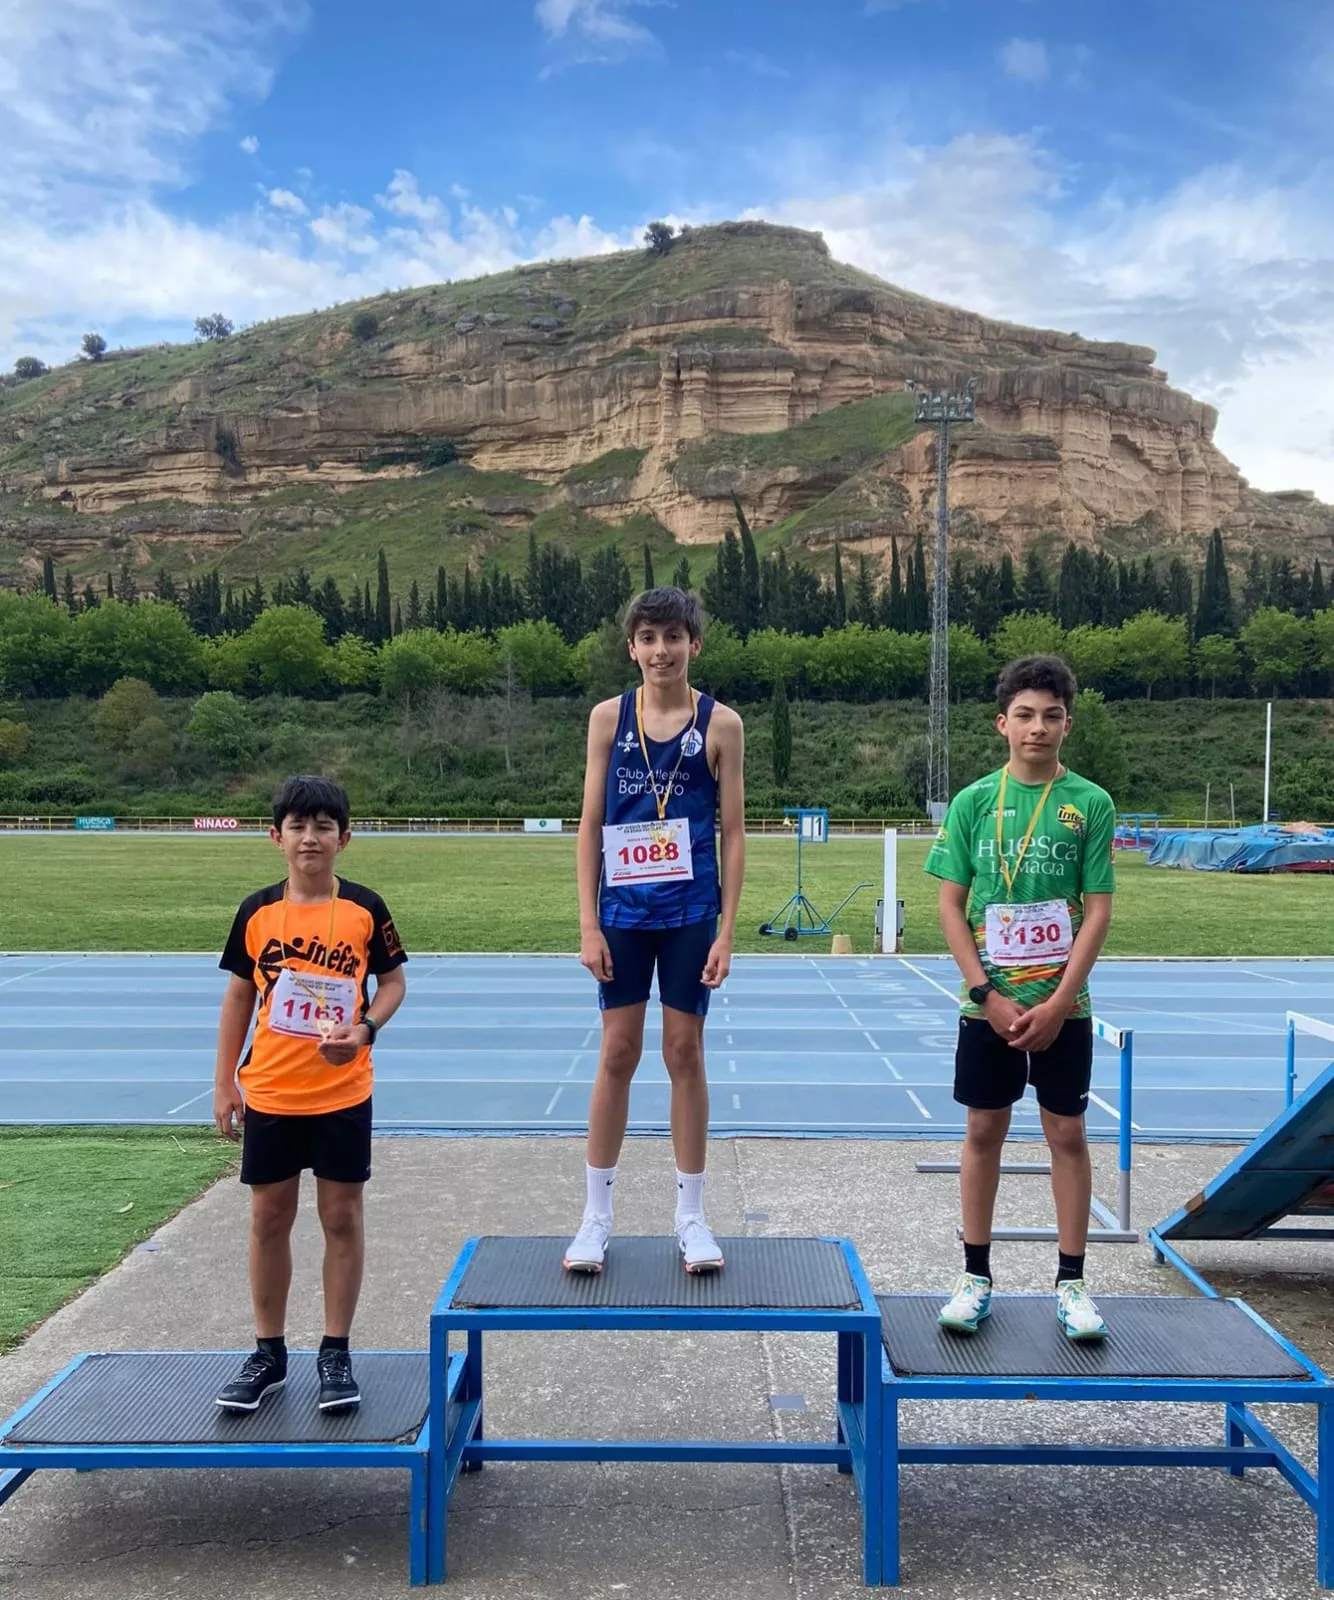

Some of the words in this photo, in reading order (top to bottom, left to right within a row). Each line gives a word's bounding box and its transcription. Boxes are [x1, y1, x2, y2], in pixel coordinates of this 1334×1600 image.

[616, 767, 643, 780] Club
[194, 818, 238, 829] HINACO
[618, 842, 679, 865] 1088
[999, 923, 1061, 945] 1130
[283, 999, 344, 1025] 1163
